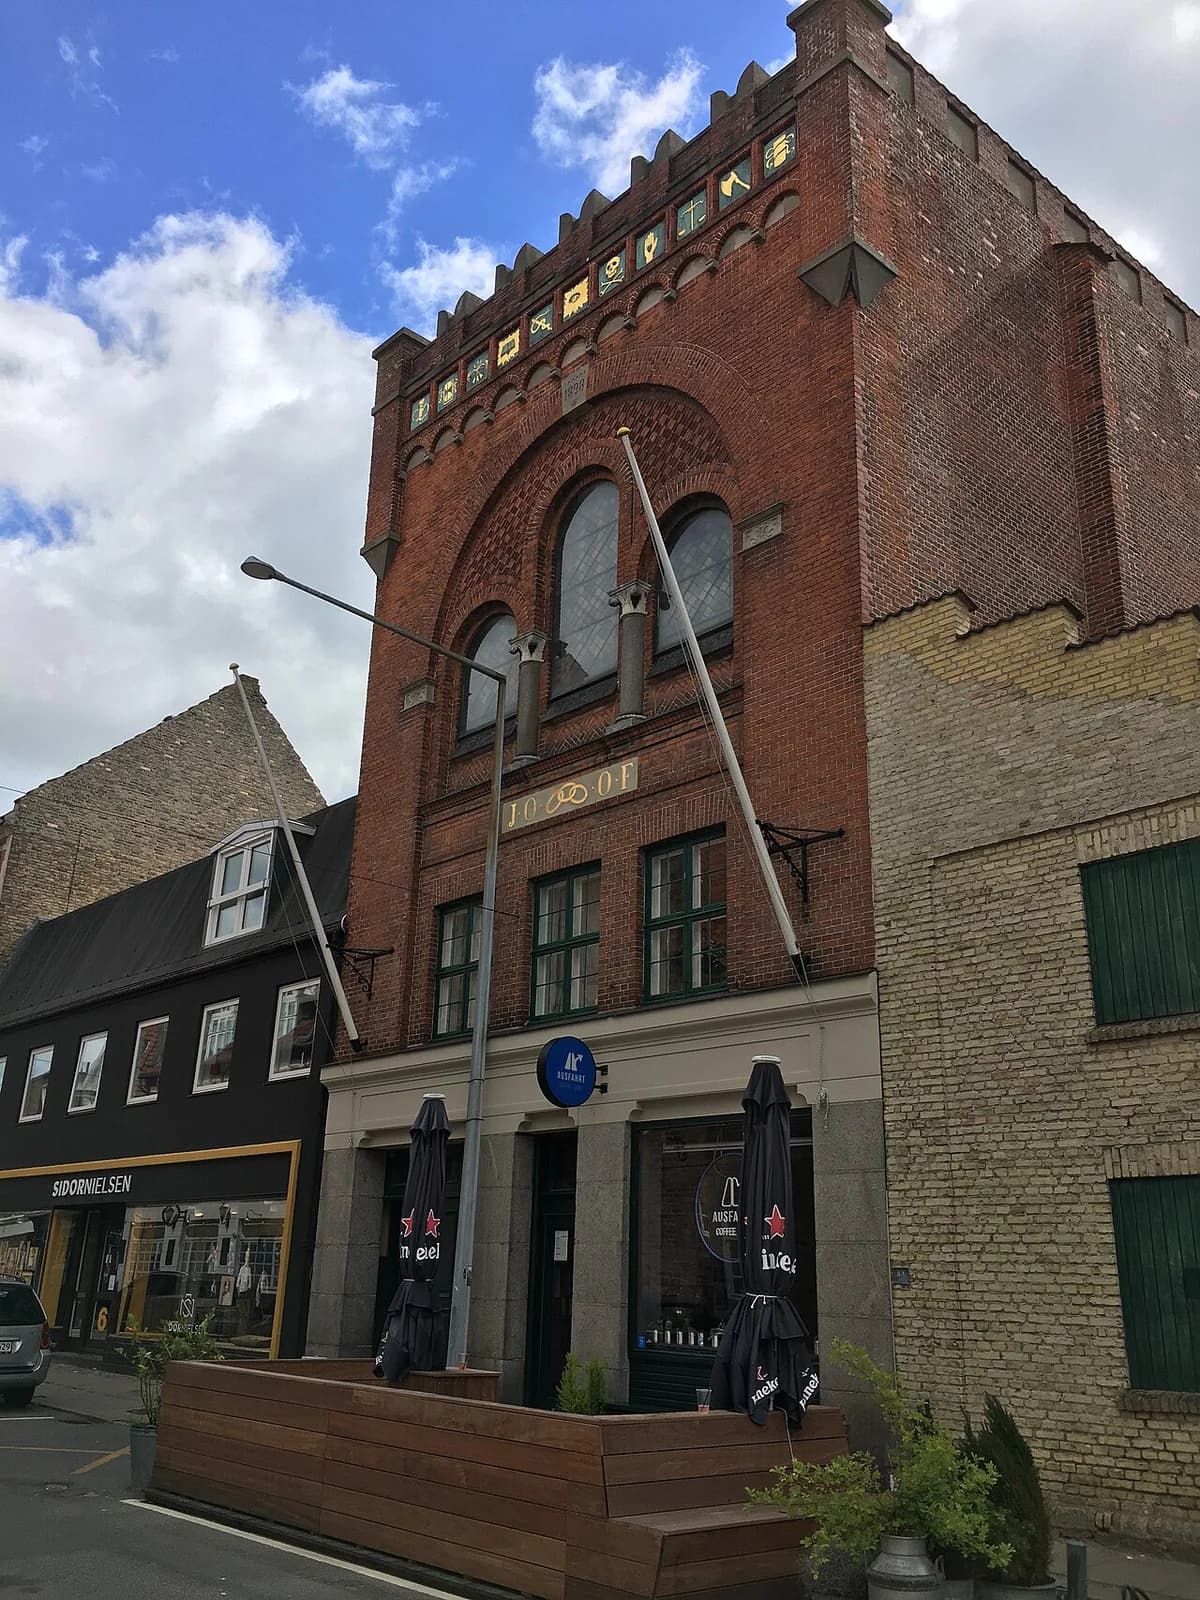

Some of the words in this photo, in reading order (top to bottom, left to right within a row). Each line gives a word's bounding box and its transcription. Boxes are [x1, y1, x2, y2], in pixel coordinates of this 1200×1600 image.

[557, 1071, 585, 1083] AUSFAHRT
[52, 1174, 132, 1197] SIDORNIELSEN
[712, 1211, 739, 1223] AUSFA
[715, 1227, 737, 1236] COFFEE
[98, 1306, 108, 1332] 6
